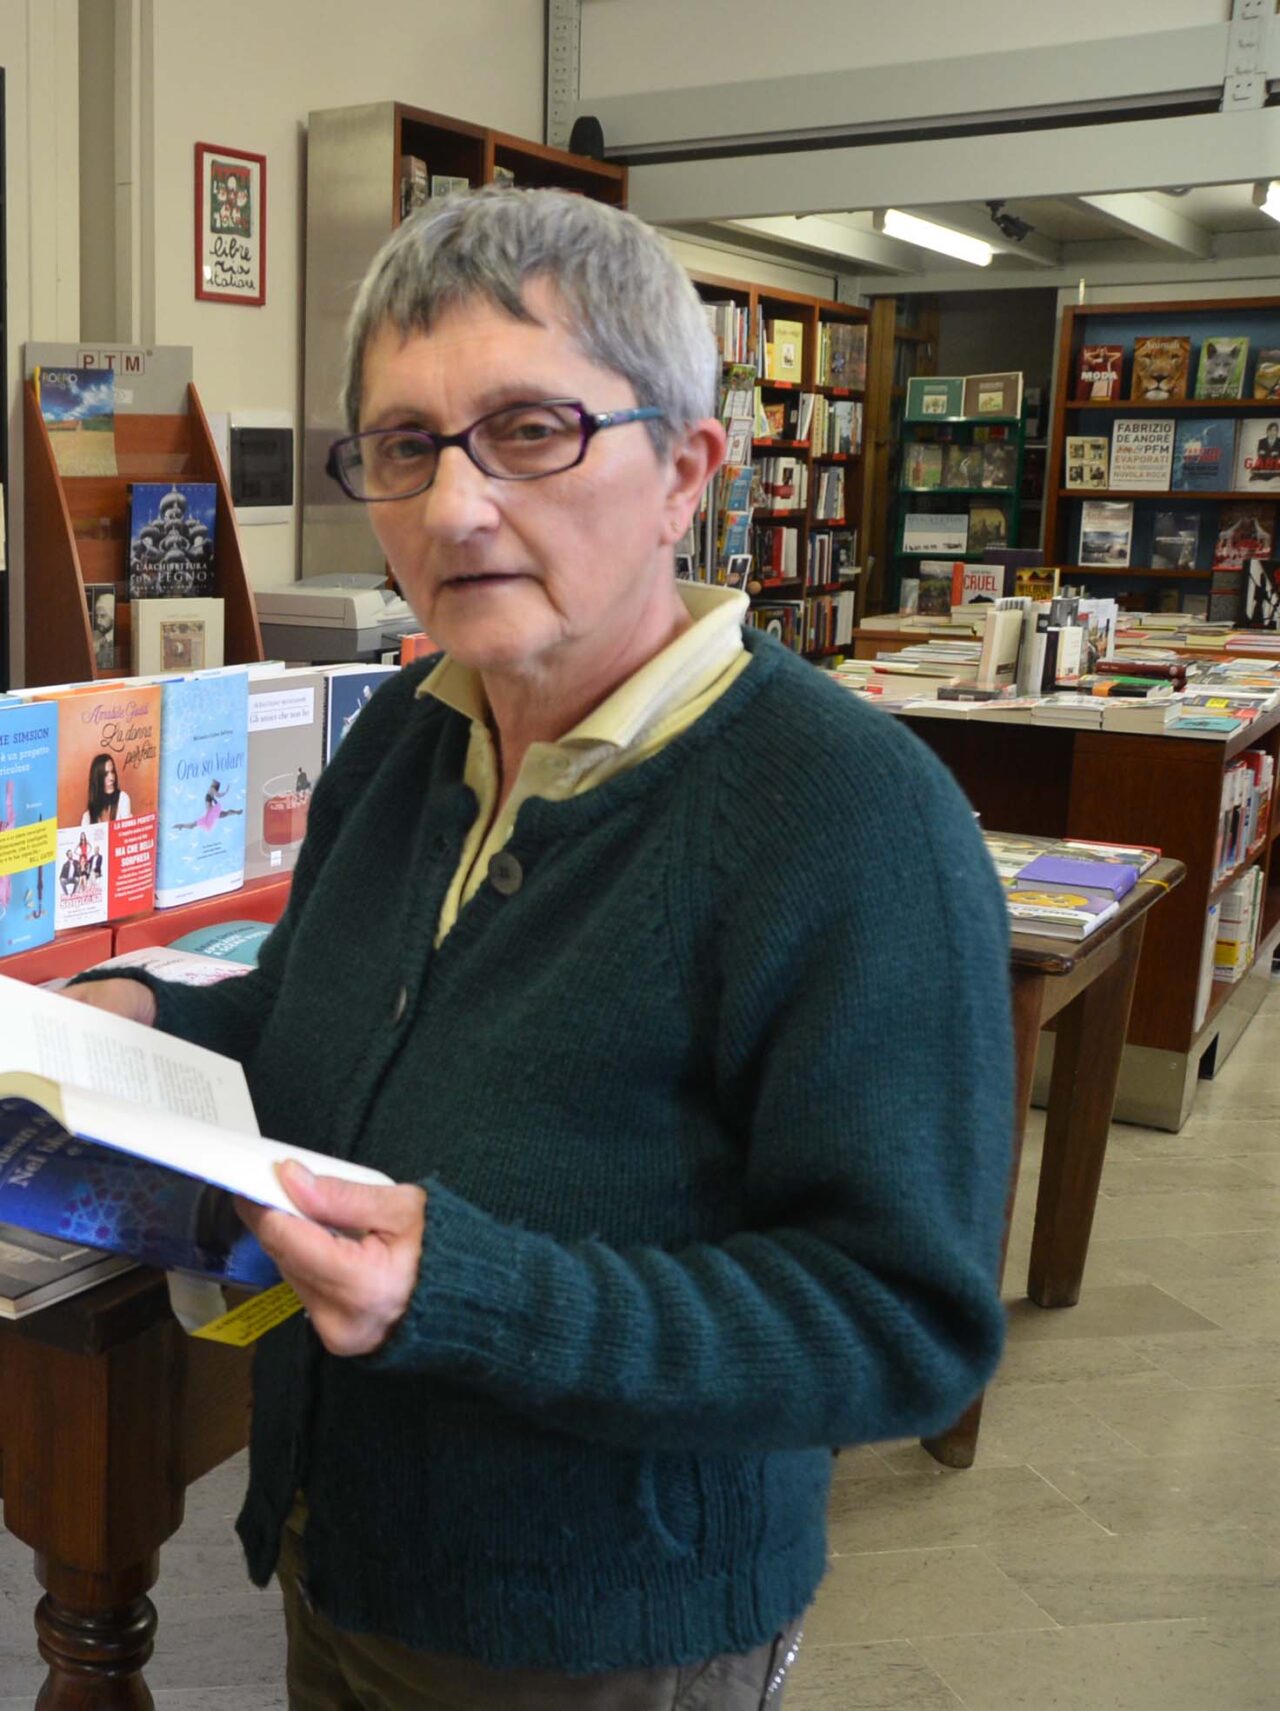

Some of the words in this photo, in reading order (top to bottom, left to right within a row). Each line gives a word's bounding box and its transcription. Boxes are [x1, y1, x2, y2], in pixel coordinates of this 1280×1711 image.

[209, 236, 252, 262] libre
[82, 354, 140, 372] PTM
[1080, 370, 1119, 381] MODA
[1117, 423, 1172, 433] FABRIZIO
[1116, 434, 1131, 443] DE
[1144, 444, 1170, 454] PFM
[1115, 455, 1169, 464] EVAPORATI
[963, 574, 998, 592] CRUEL
[278, 710, 289, 720] che
[12, 727, 50, 745] SIMSION
[19, 746, 50, 760] progetto
[176, 758, 199, 781] Ora
[202, 760, 214, 777] so
[8, 1154, 48, 1189] Nel
